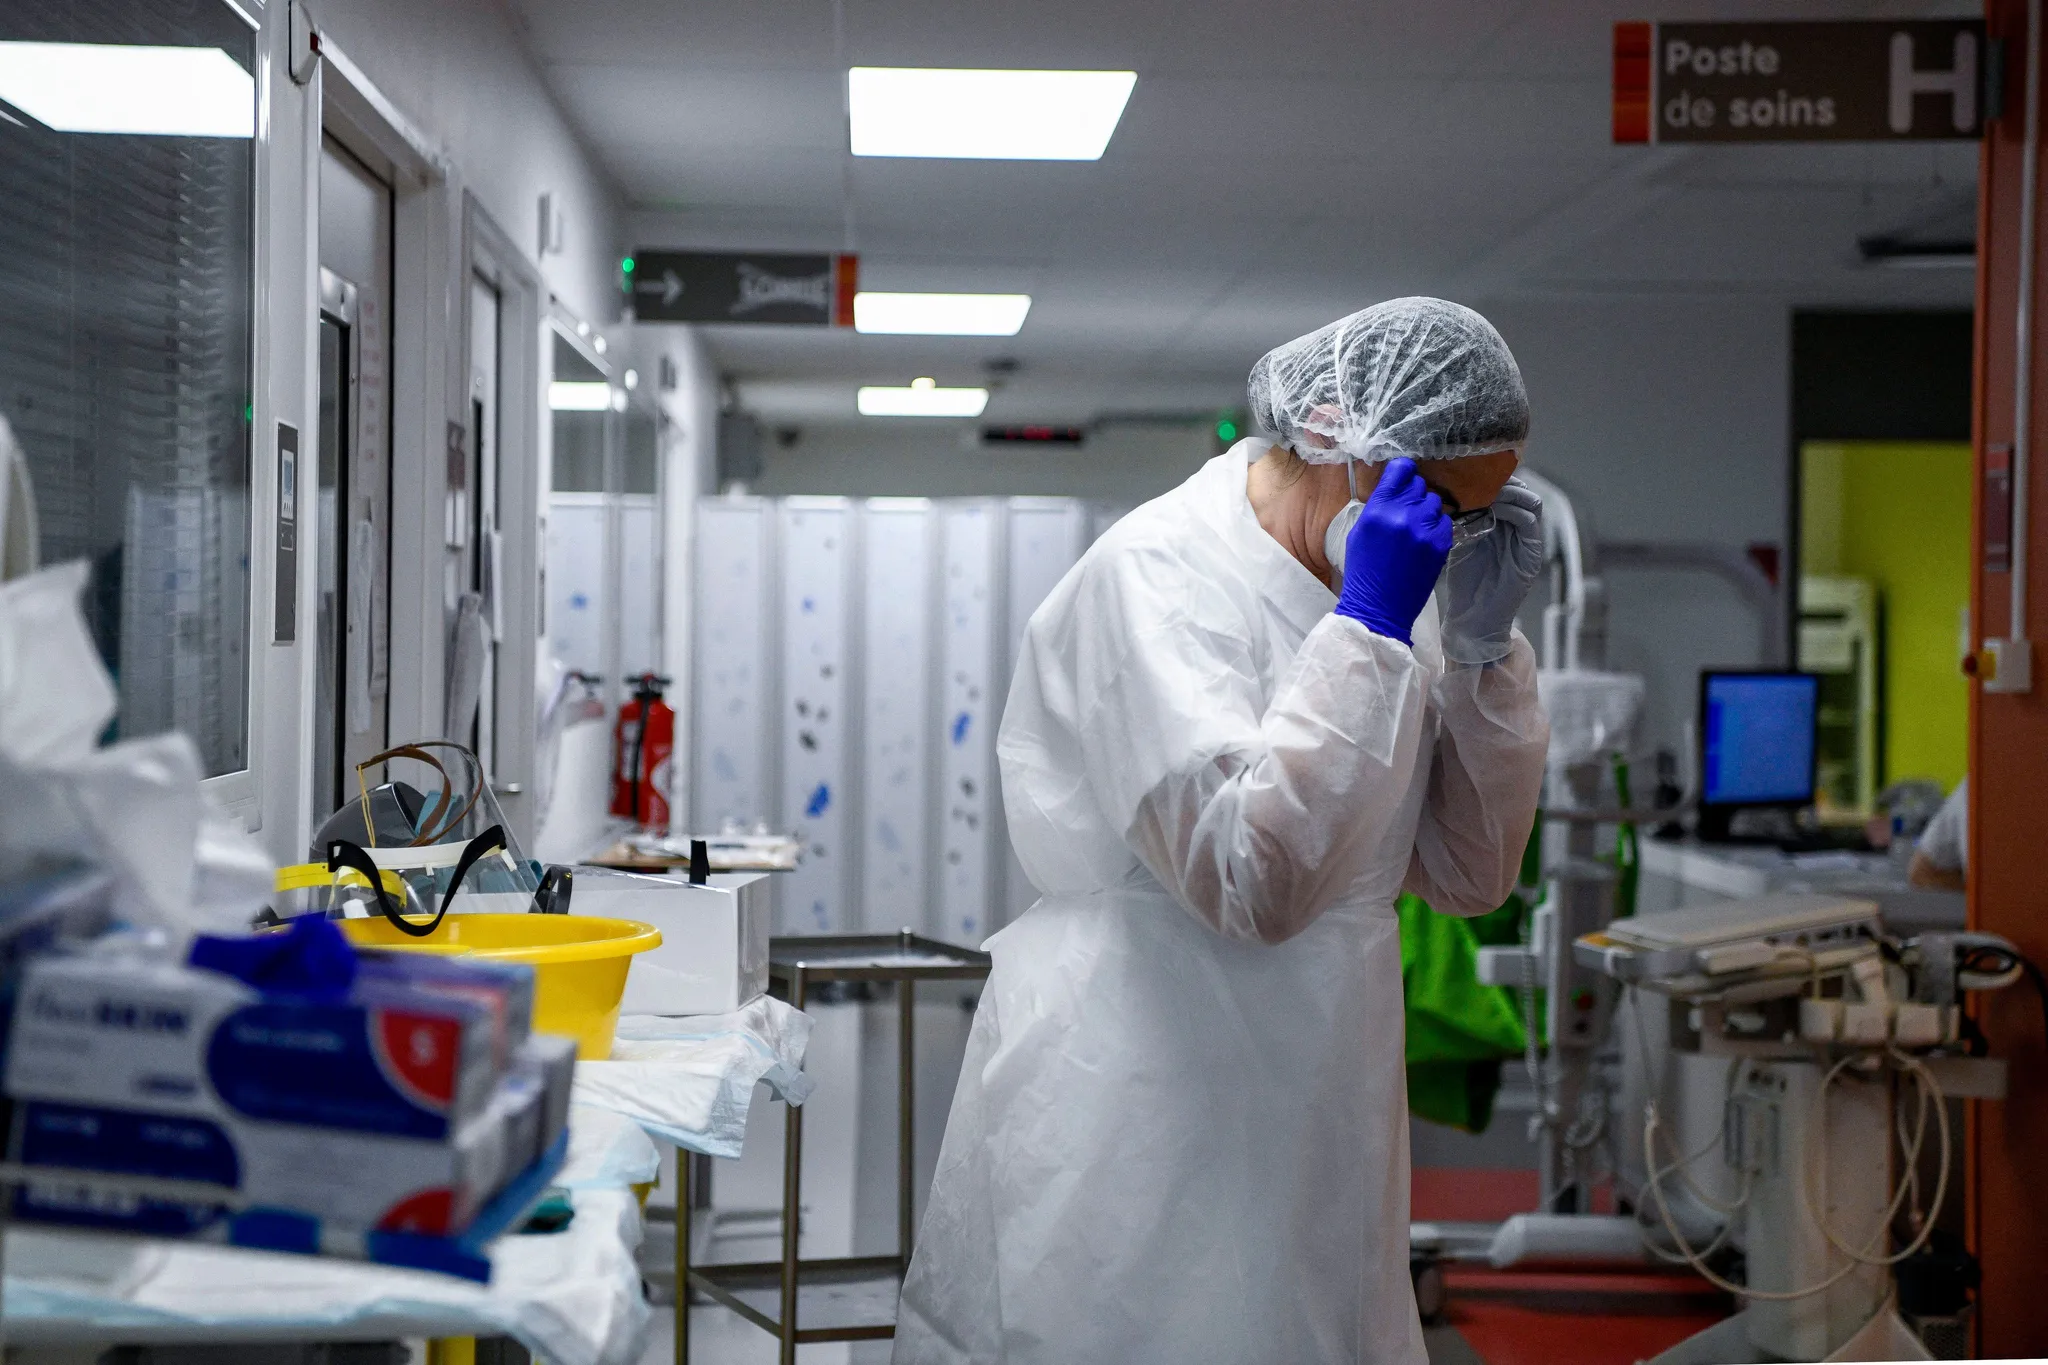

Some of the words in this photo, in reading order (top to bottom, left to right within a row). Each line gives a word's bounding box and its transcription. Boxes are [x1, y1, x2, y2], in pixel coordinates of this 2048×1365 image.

[1666, 40, 1780, 76] Poste
[1889, 31, 1977, 133] H
[1665, 90, 1716, 128] de
[1728, 89, 1837, 128] soins
